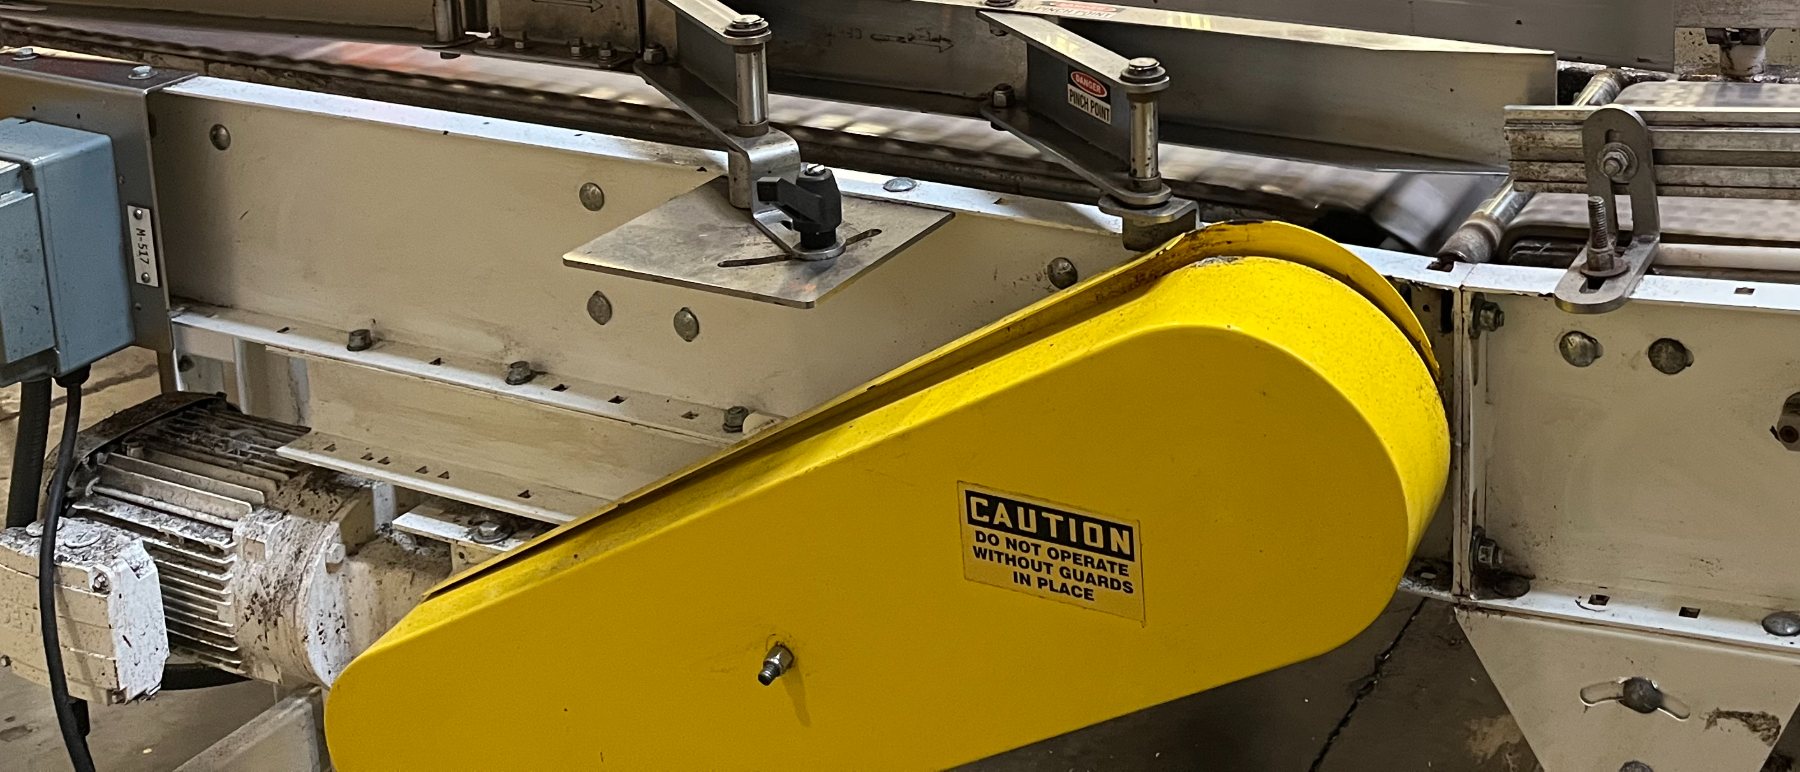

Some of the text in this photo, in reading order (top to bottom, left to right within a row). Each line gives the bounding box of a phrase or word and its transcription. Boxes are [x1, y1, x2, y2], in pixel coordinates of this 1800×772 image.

[1075, 73, 1101, 94] DANGER
[1069, 88, 1110, 122] PINCH POINT
[136, 227, 150, 265] M-517
[969, 495, 1131, 556] CAUTION
[972, 545, 1134, 594] WITHOUT GUARDS
[975, 530, 1130, 577] DO NOT OPERATE
[1013, 571, 1095, 602] IN PLACE
